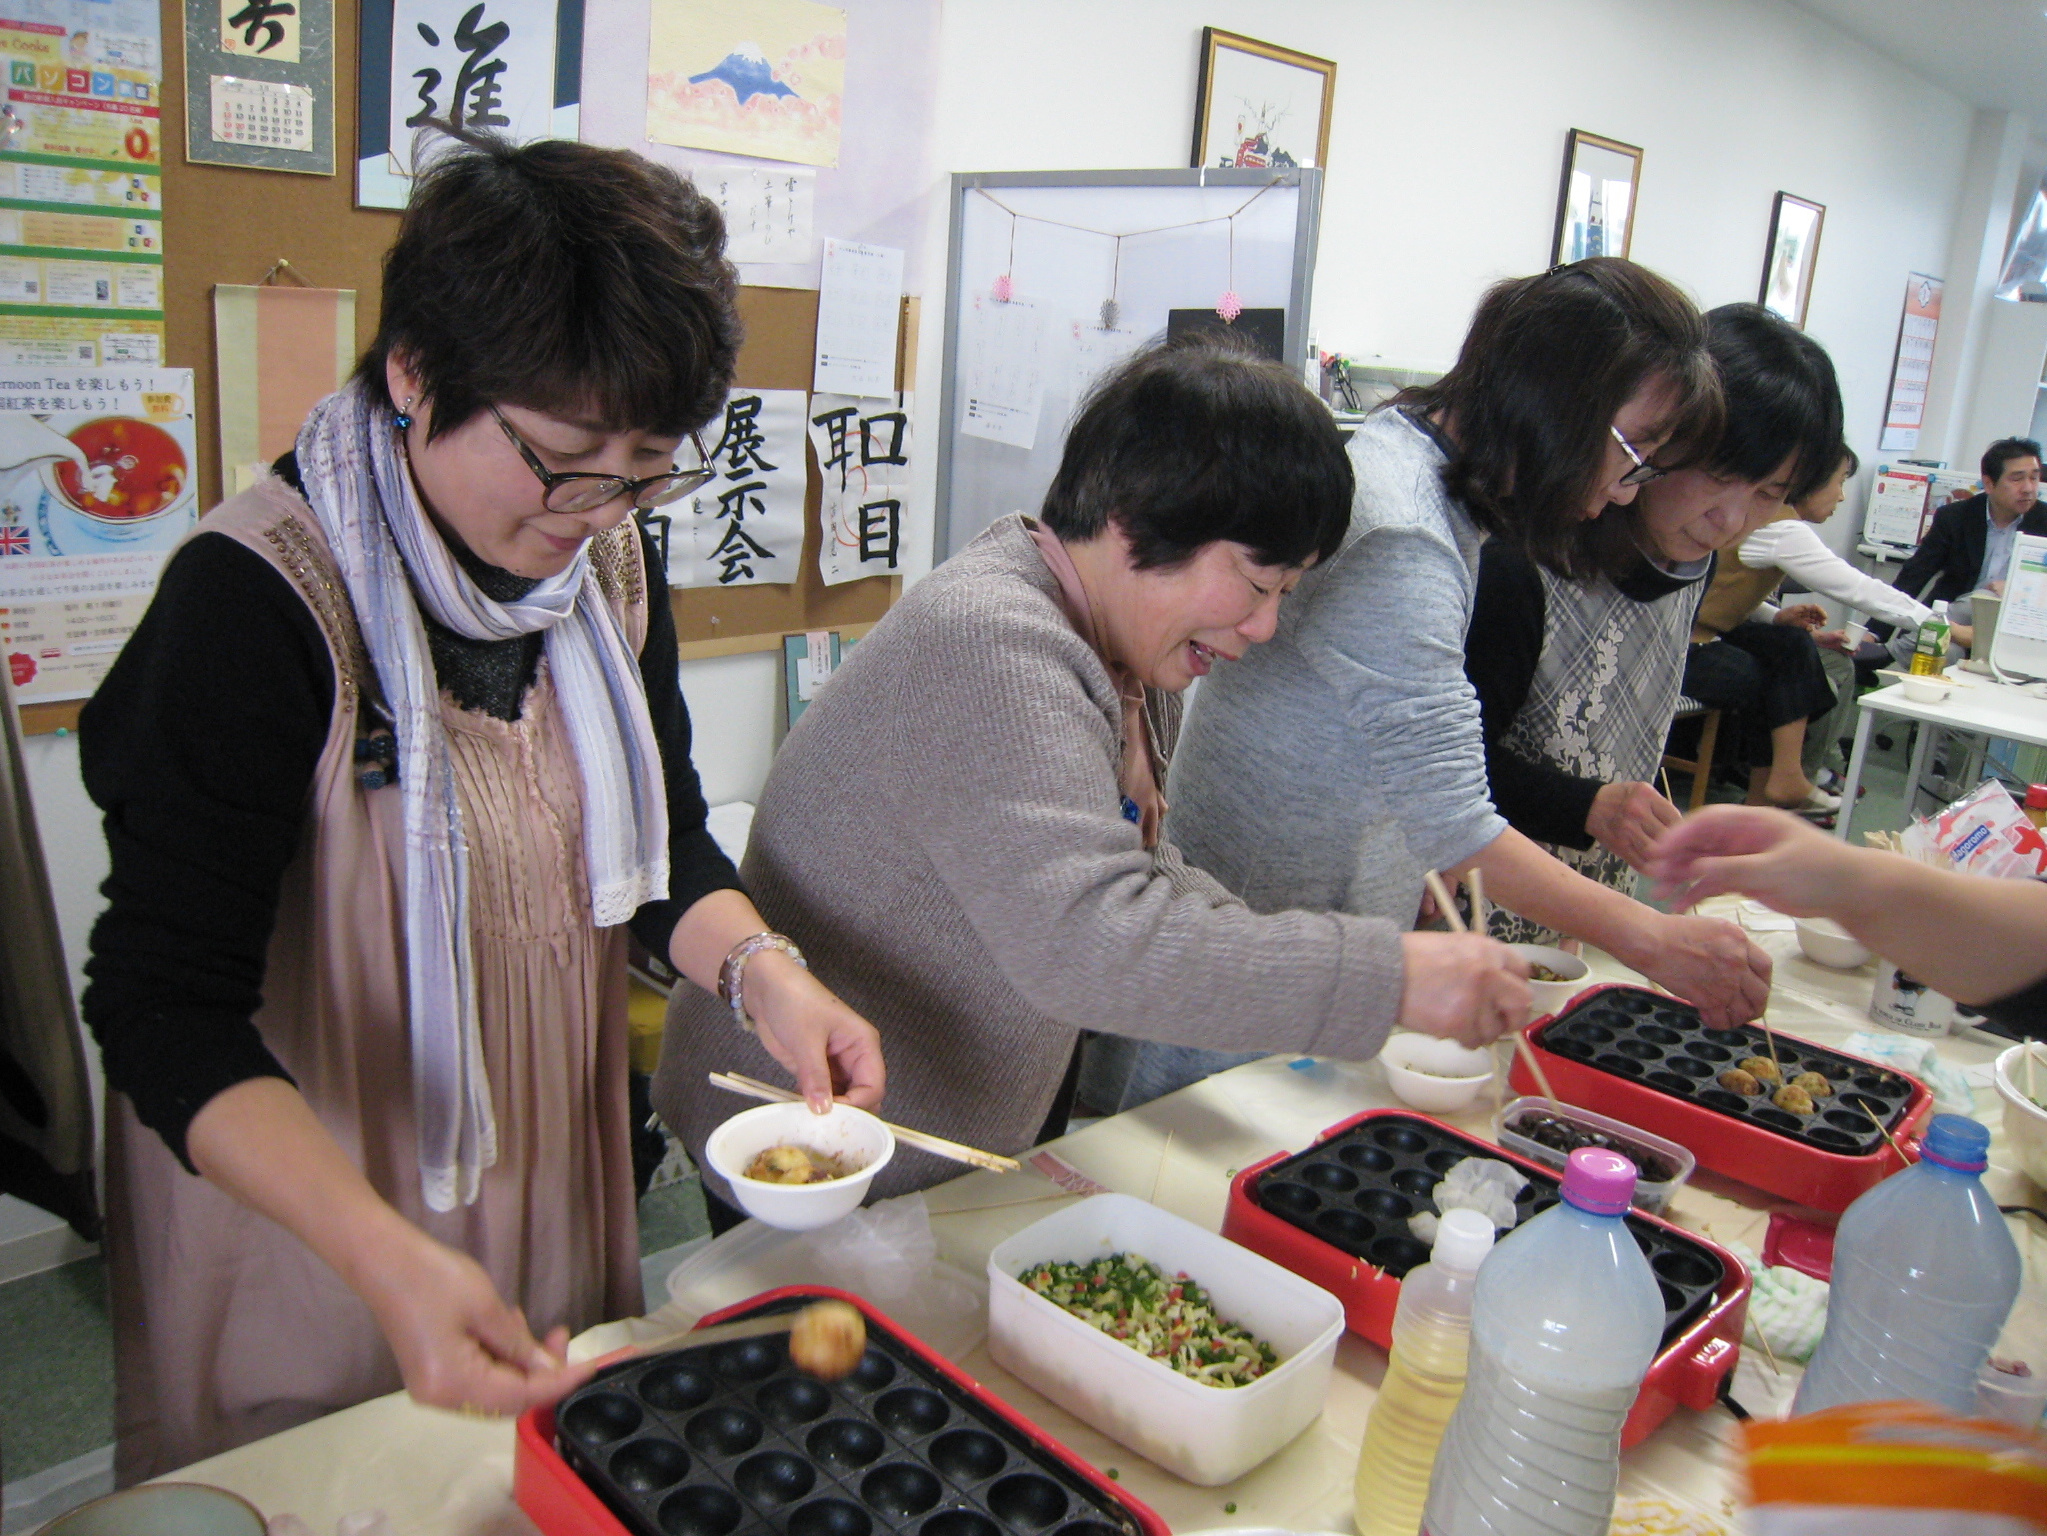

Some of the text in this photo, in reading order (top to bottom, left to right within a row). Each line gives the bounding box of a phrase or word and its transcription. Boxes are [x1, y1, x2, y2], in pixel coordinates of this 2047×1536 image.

[15, 66, 148, 98] パソコン
[406, 2, 511, 129] 進
[45, 378, 70, 389] Tea
[707, 395, 779, 584] 展示会
[812, 406, 860, 494] 耳
